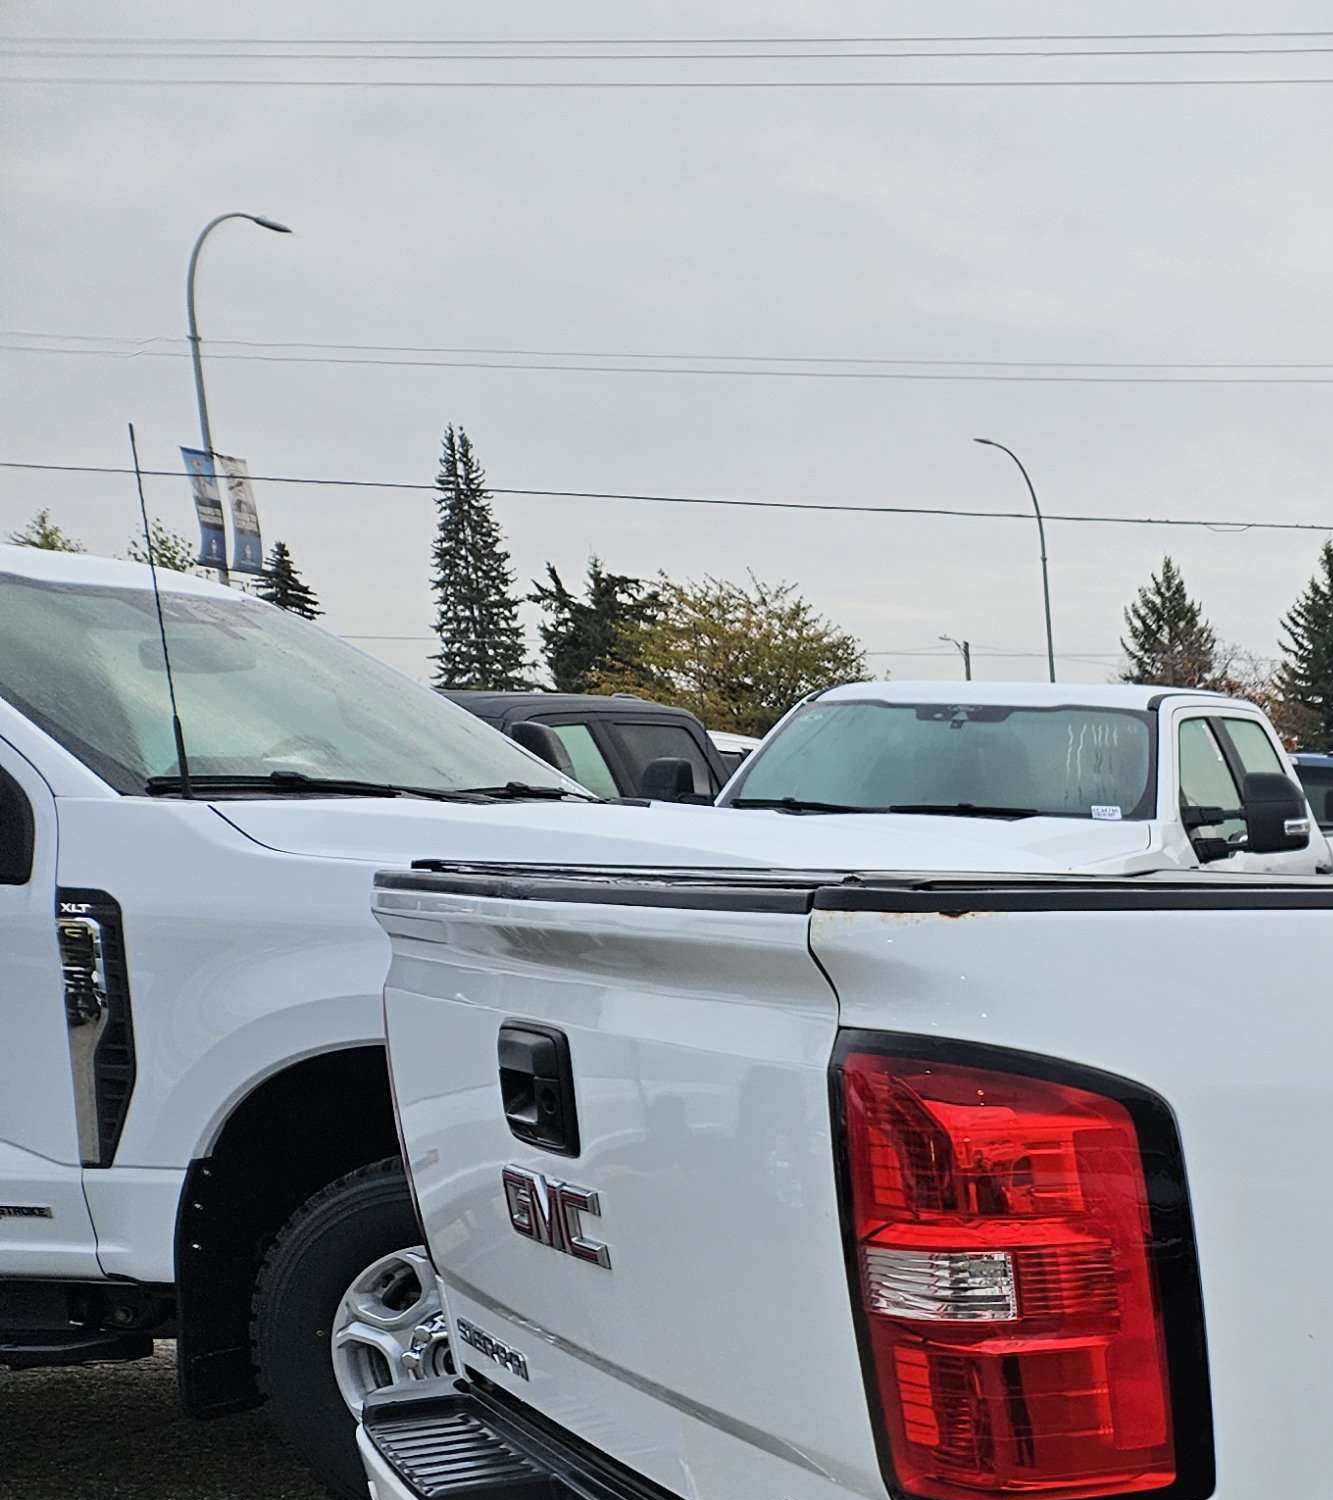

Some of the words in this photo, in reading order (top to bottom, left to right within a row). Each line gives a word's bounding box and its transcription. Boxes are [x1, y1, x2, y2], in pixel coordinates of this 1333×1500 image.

[60, 903, 92, 913] XLT
[502, 1163, 613, 1271] GMC
[457, 1316, 529, 1382] SIERRA
